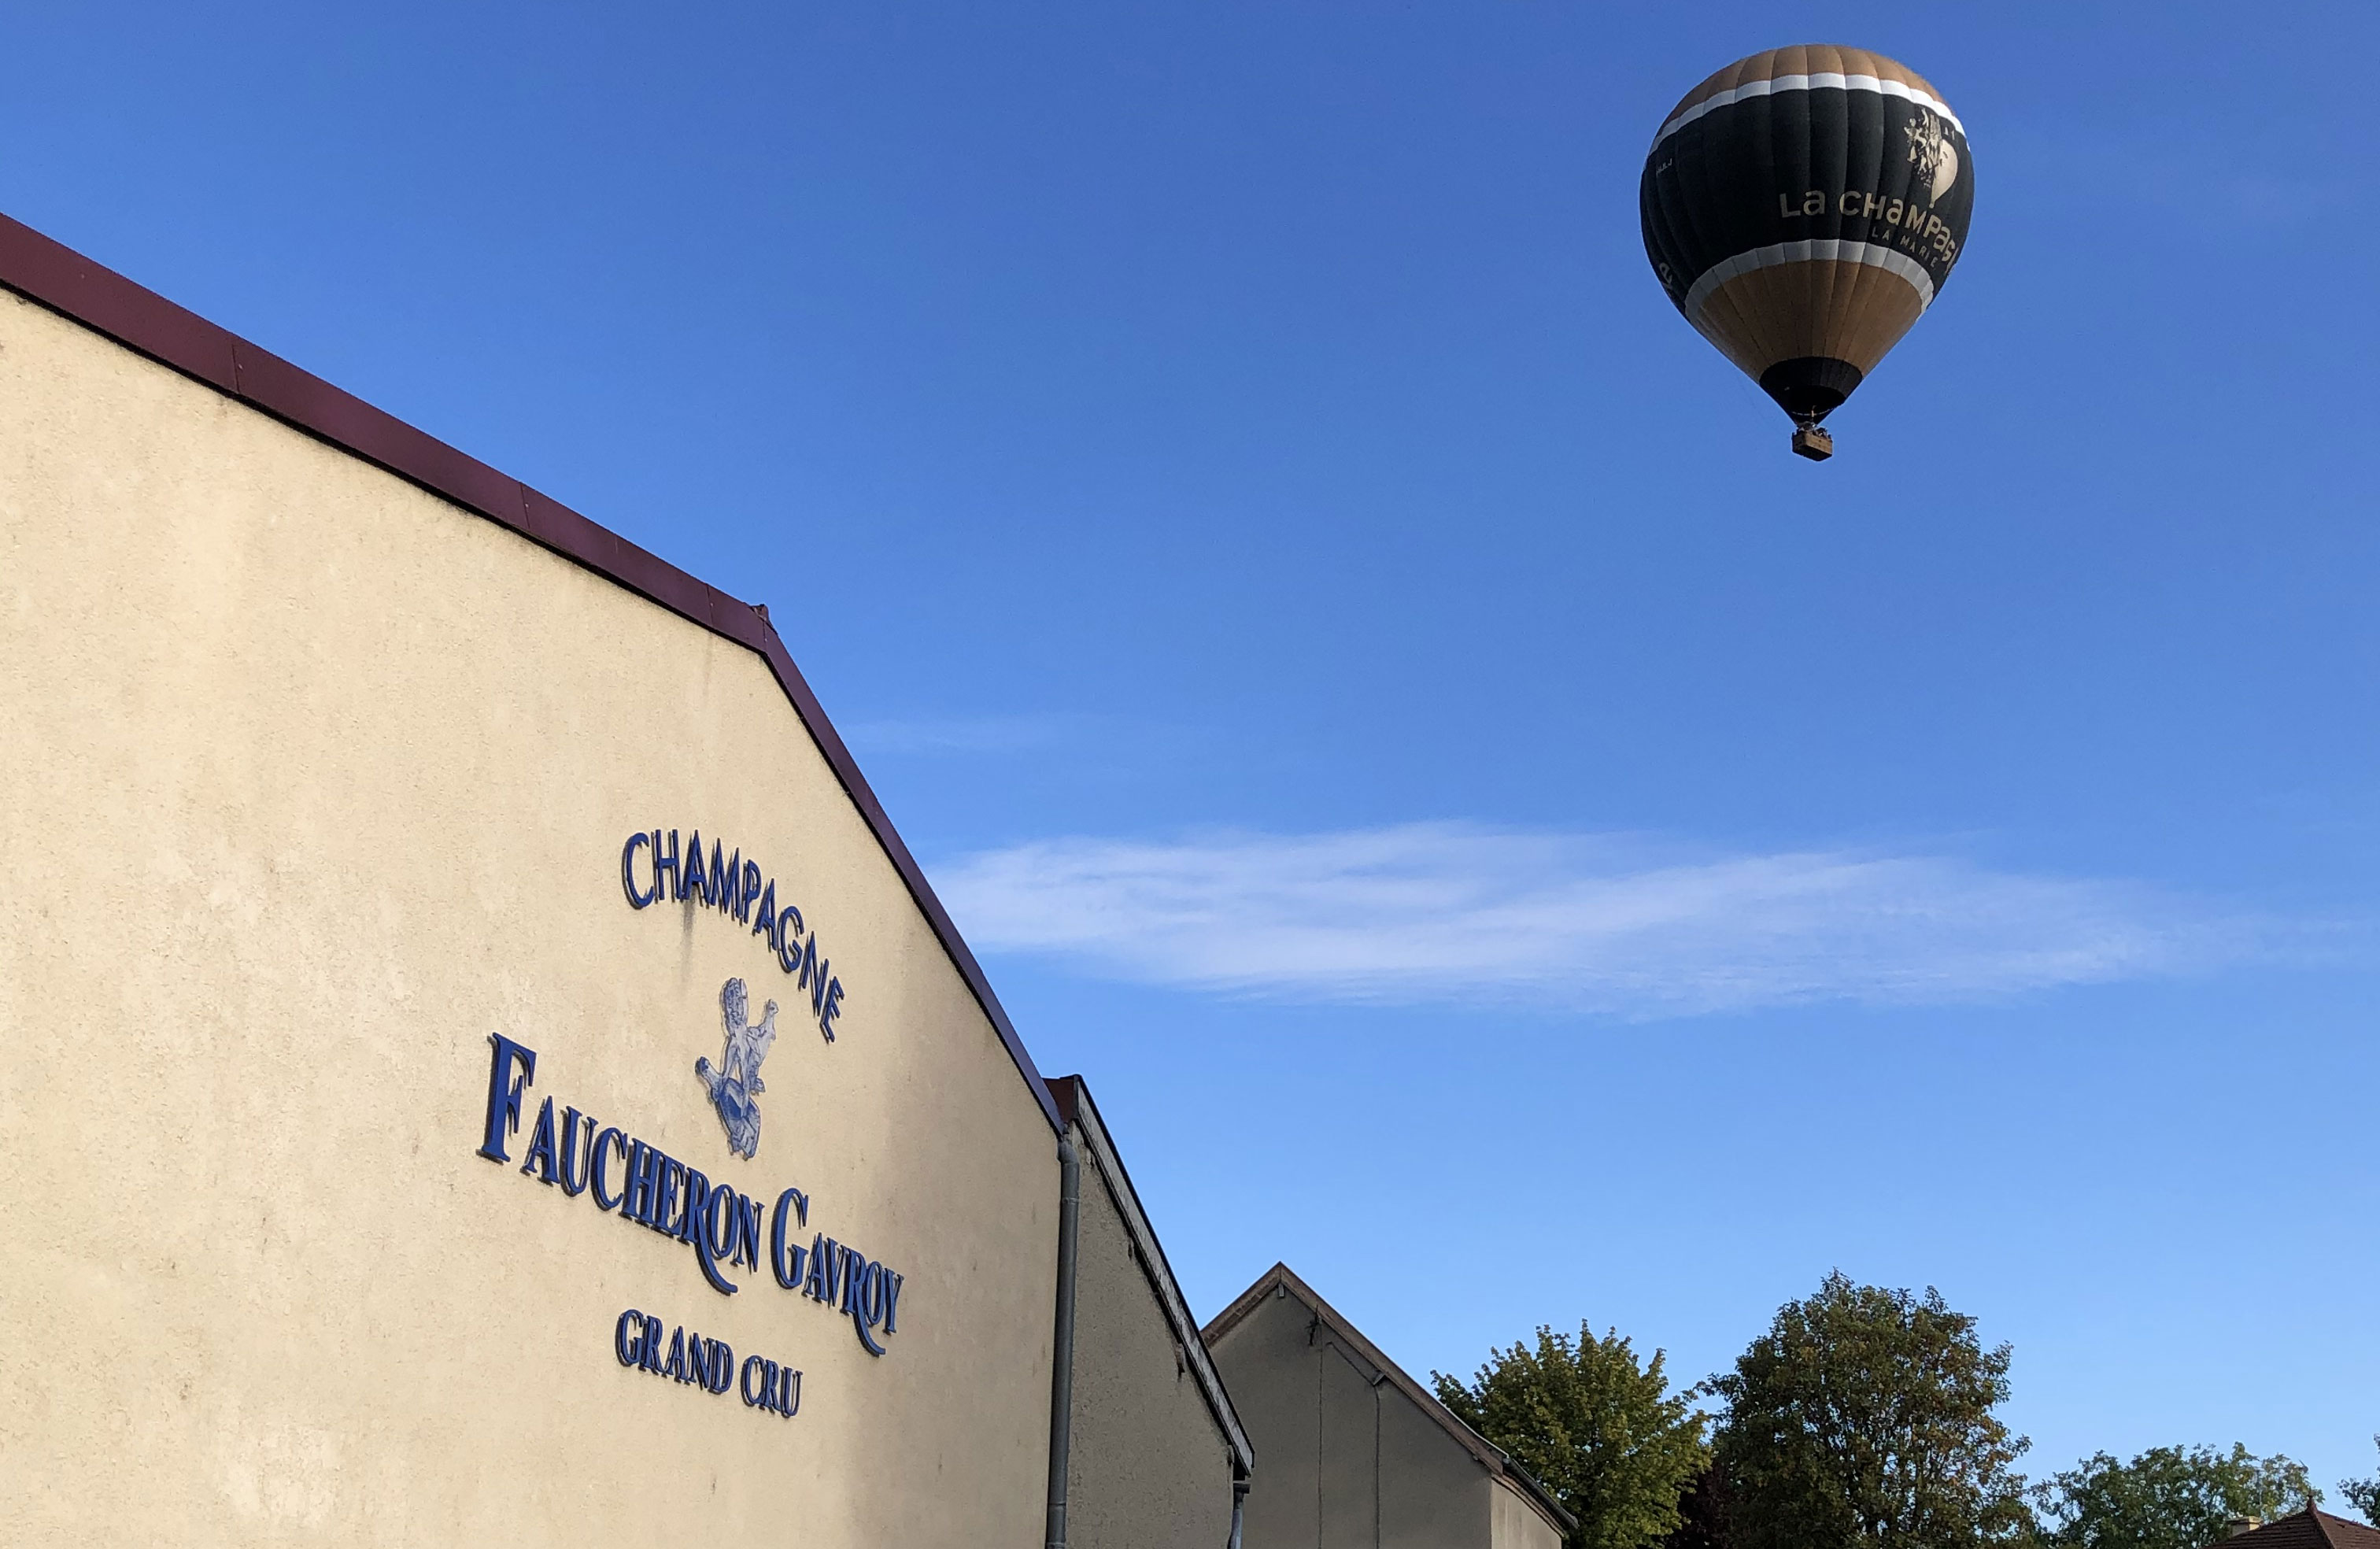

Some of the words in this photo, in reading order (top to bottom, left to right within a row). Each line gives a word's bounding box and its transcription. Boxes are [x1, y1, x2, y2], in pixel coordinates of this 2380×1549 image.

[1871, 226, 1890, 241] LA
[622, 828, 844, 1043] CHAMPAGNE
[477, 1032, 765, 1294] FAUCHERON
[770, 1188, 904, 1357] GAVROY
[615, 1309, 734, 1394] GRAND
[741, 1355, 803, 1418] CRU
